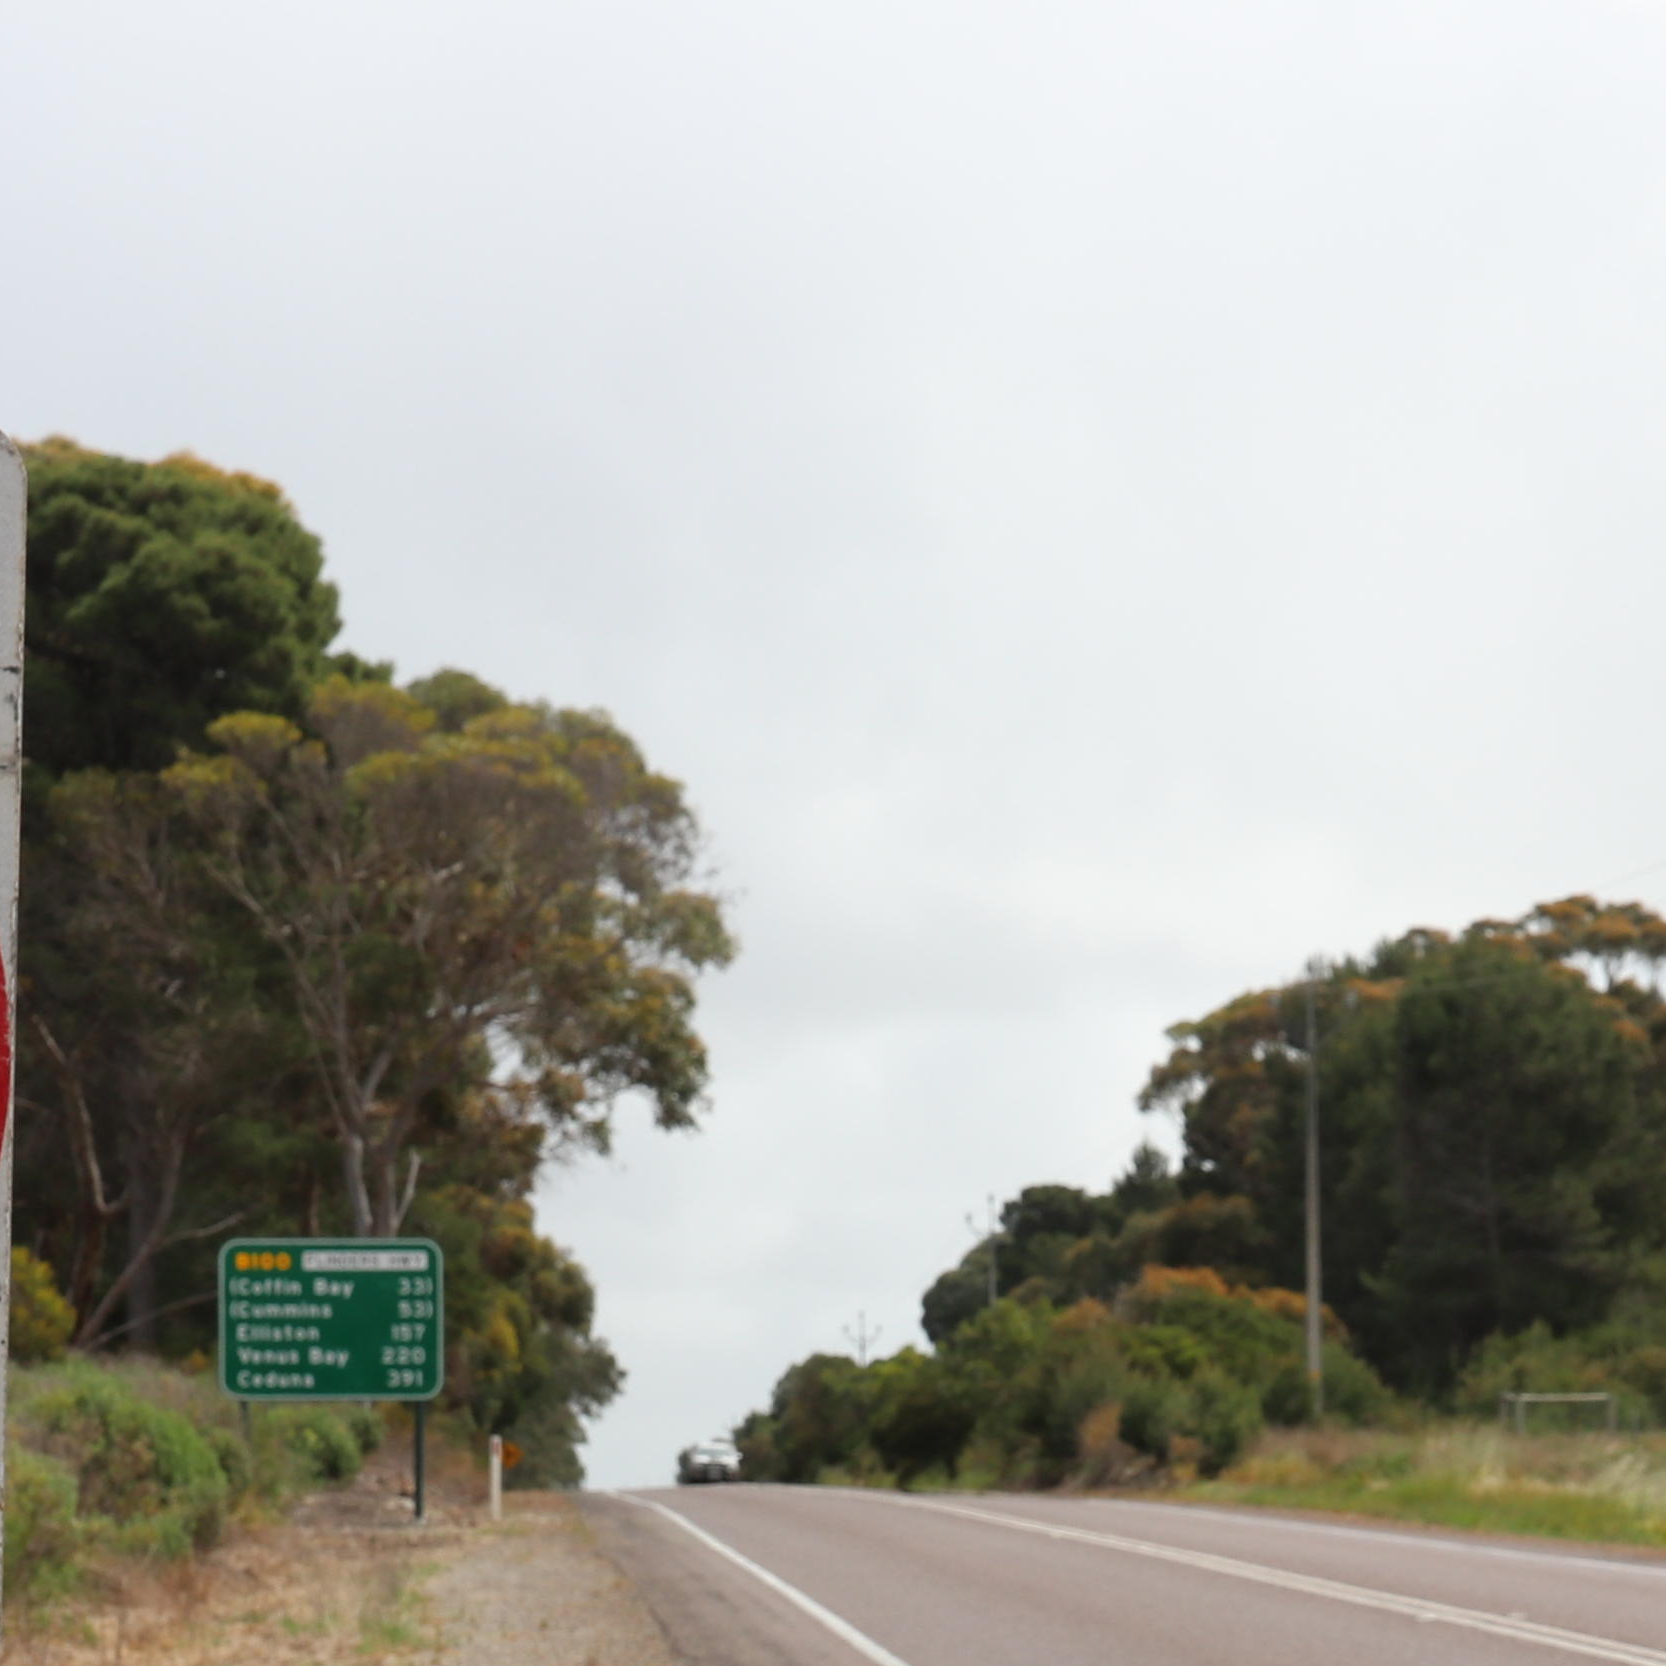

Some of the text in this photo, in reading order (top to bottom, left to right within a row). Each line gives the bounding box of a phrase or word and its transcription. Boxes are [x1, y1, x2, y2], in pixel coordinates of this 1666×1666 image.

[313, 1277, 355, 1299] Bay
[236, 1323, 320, 1342] Elliston
[236, 1347, 300, 1365] Venus
[308, 1346, 349, 1368] Bay
[236, 1370, 315, 1388] Ceduna
